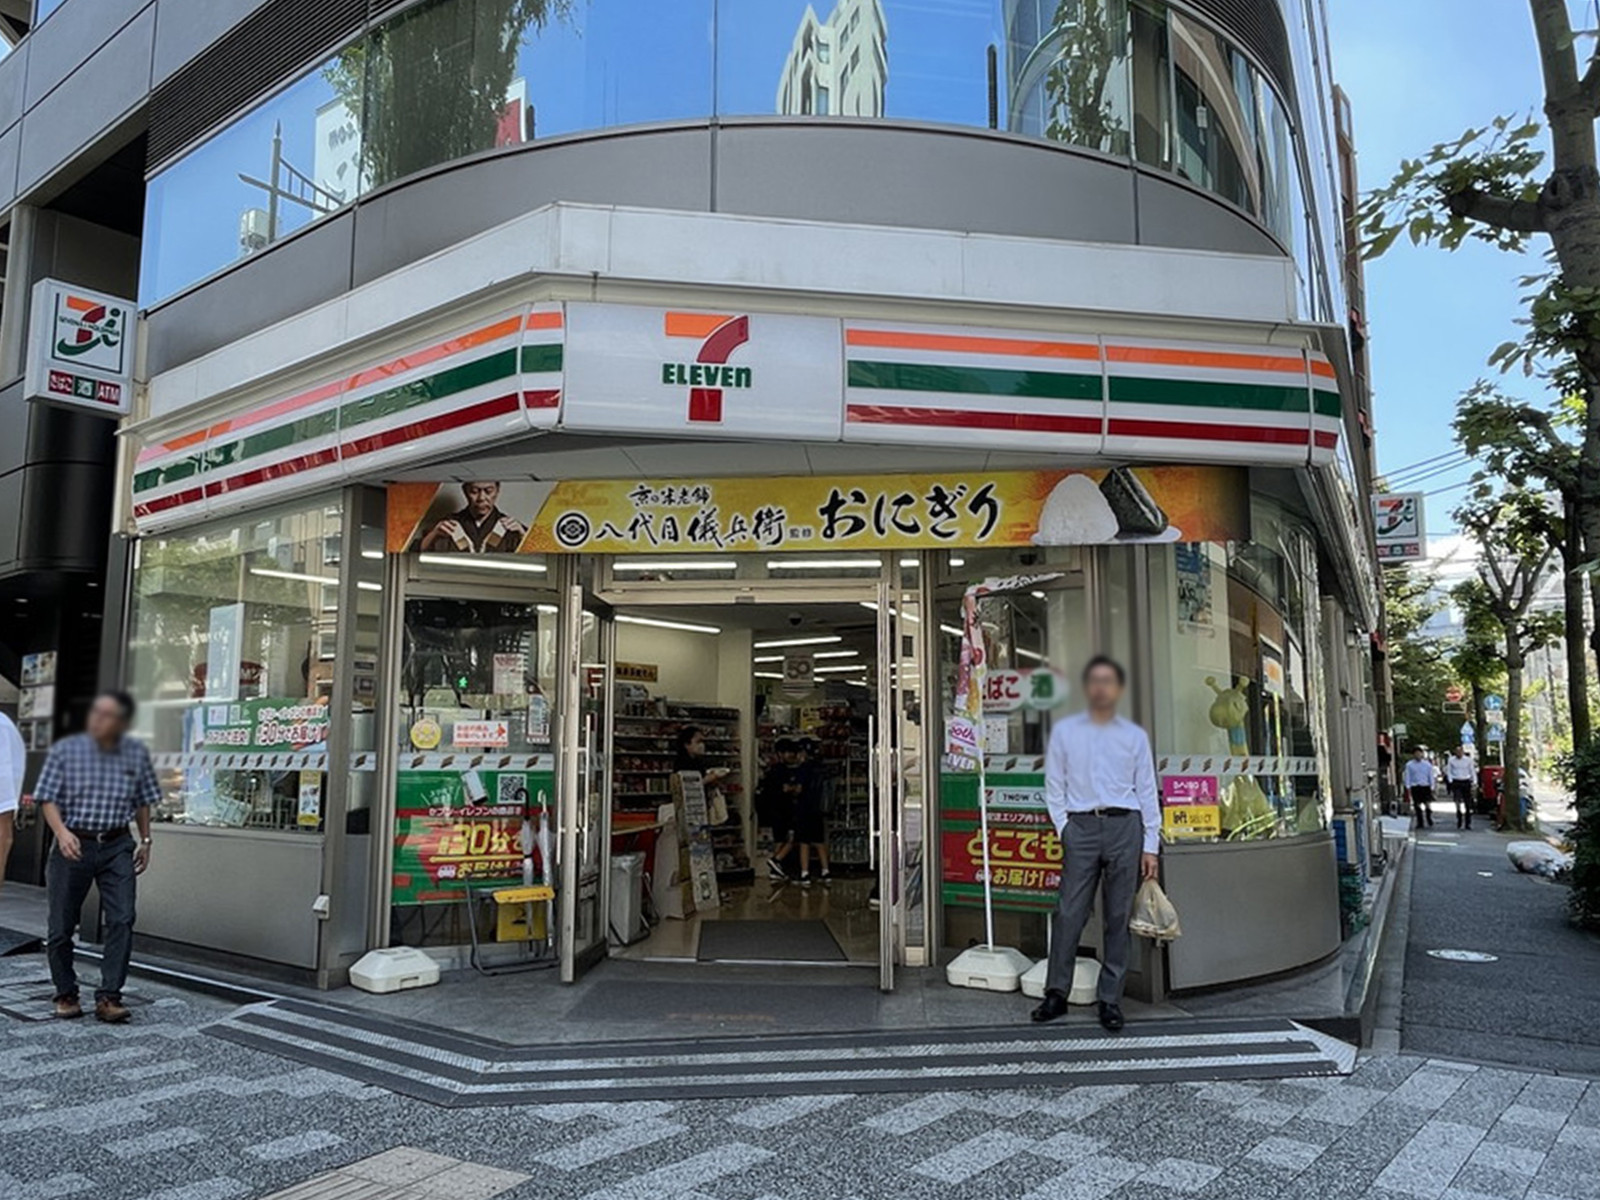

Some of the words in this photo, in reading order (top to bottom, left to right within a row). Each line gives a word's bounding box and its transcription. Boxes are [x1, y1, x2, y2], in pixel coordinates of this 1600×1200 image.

[97, 384, 120, 401] ATM
[818, 483, 999, 540] おにぎり
[982, 674, 1020, 700] ばこ
[966, 828, 1064, 861] どこでも
